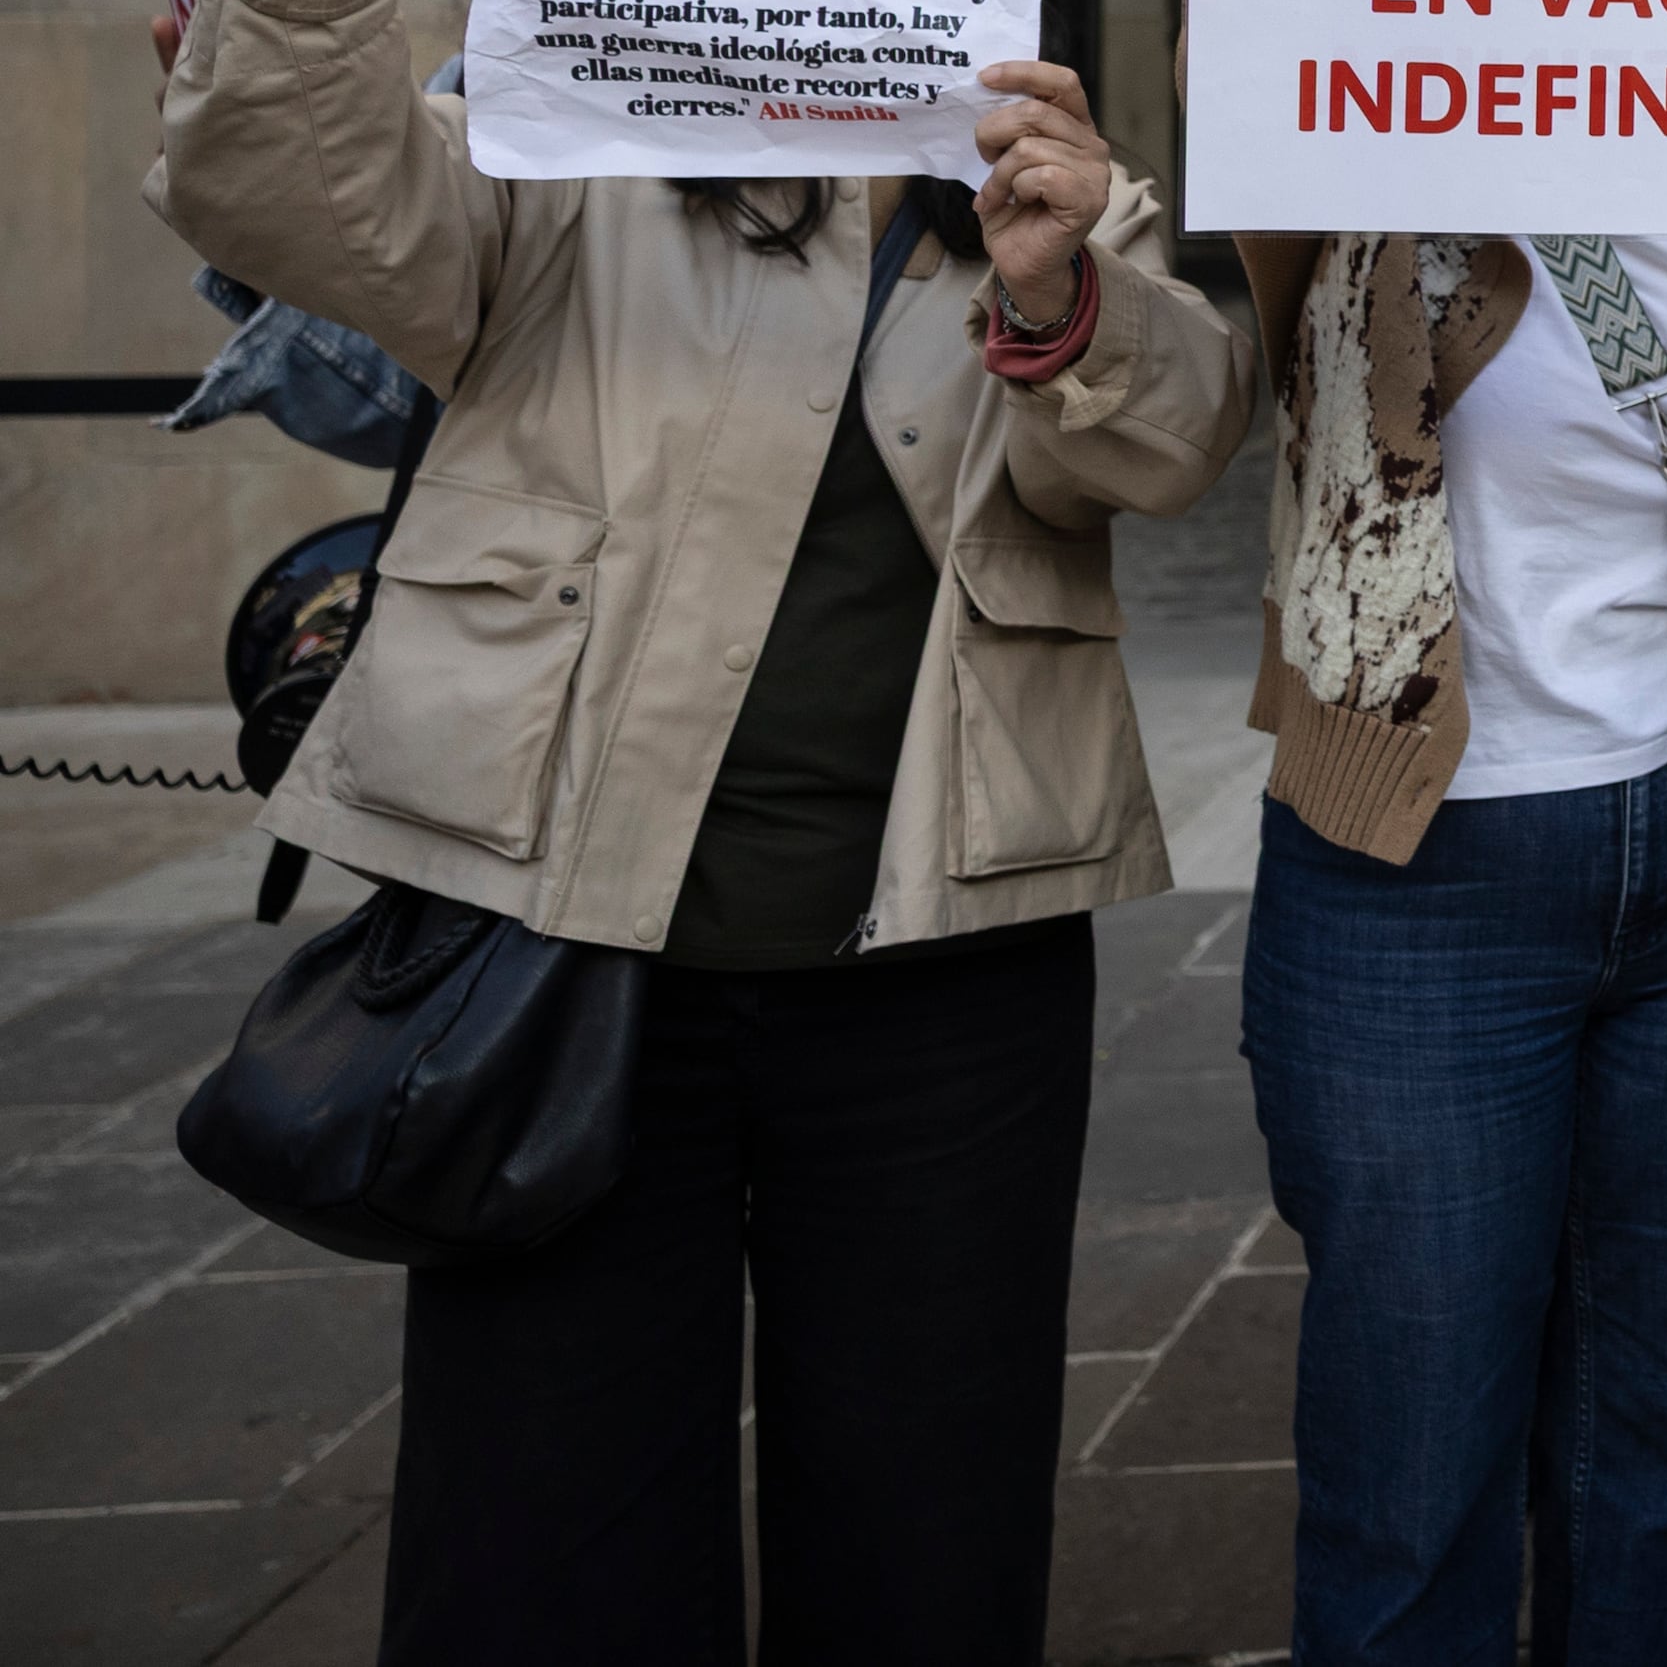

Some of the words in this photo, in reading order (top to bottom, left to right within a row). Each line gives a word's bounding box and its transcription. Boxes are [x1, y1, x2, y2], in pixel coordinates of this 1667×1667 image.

[755, 9, 811, 32] por
[818, 7, 904, 33] tanto,
[912, 6, 966, 38] hay
[535, 34, 596, 49] una
[601, 34, 705, 57] guerra
[710, 36, 867, 69] ideológica
[872, 45, 970, 67] contra
[572, 58, 643, 81] ellas
[648, 66, 789, 93] mediante
[795, 77, 919, 99] recortes
[925, 85, 942, 105] y
[760, 102, 802, 119] Ali
[806, 106, 898, 120] Smith
